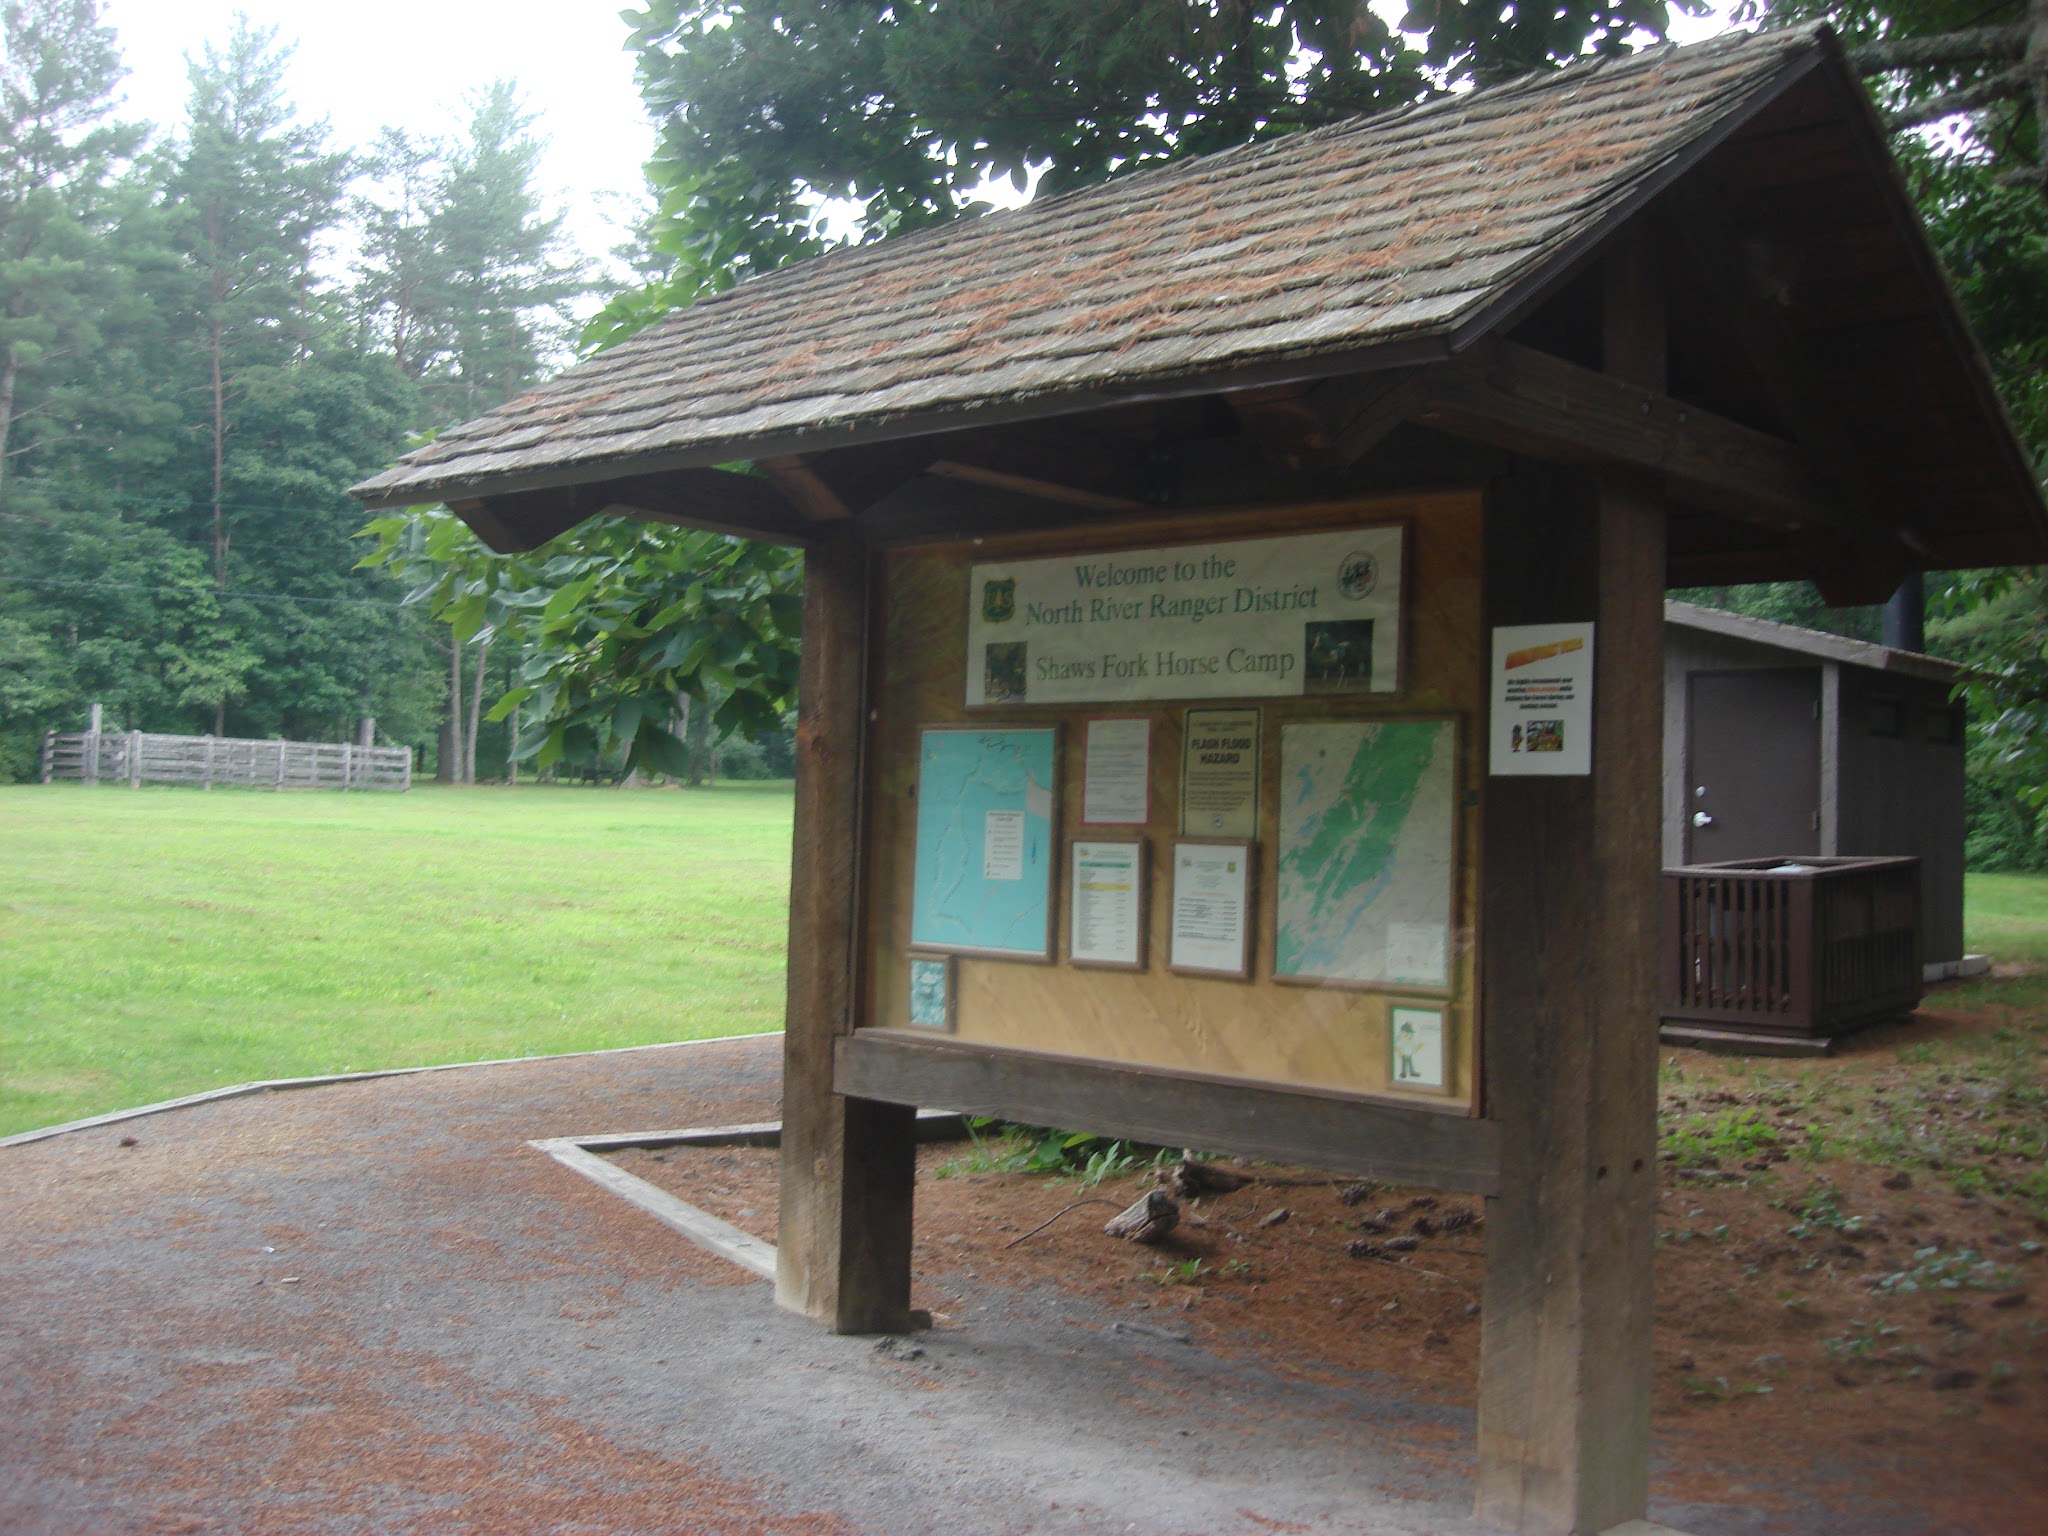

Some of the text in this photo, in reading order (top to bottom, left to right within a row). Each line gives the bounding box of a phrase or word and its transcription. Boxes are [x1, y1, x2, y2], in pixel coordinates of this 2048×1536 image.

[1074, 554, 1236, 589] Welcome to the
[1026, 584, 1319, 626] North River Ranger District
[1035, 647, 1296, 682] Shaws Fork Horse Camp
[1200, 752, 1240, 764] HAZARD
